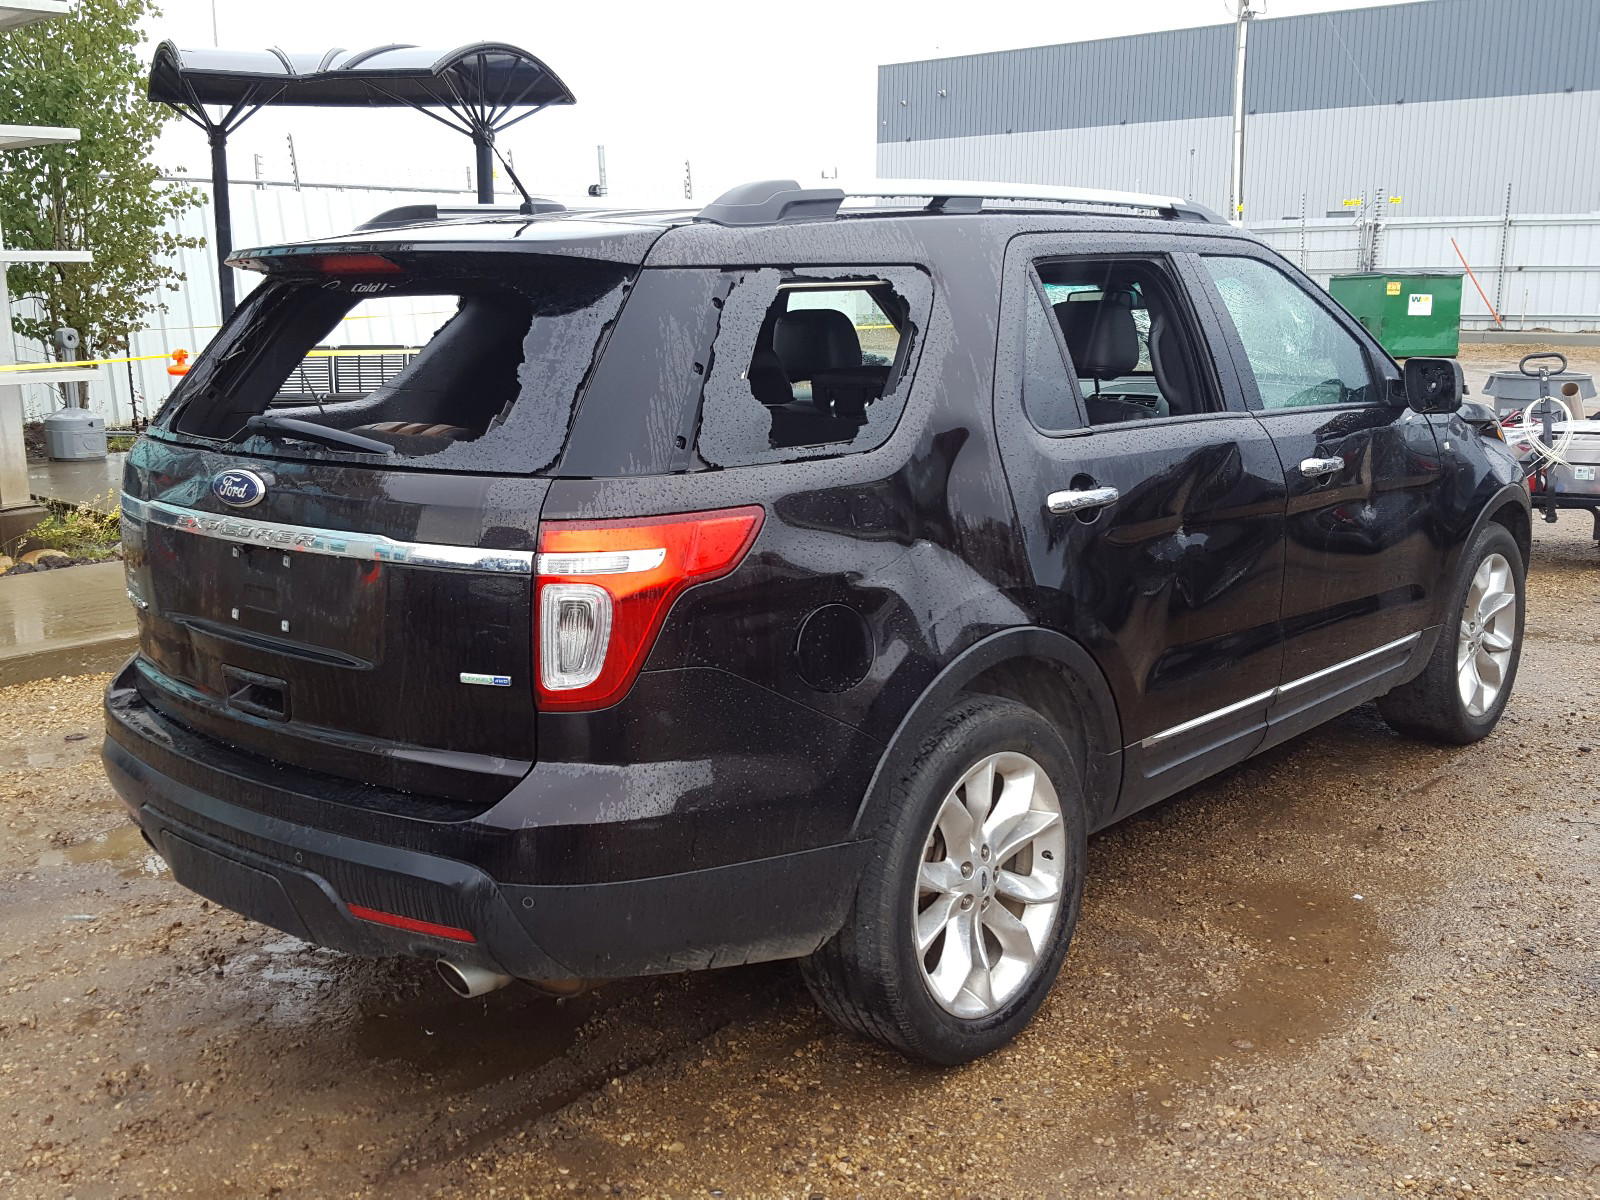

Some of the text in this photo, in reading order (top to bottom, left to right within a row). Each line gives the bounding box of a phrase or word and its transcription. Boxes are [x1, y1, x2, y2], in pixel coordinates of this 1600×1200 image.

[350, 283, 380, 293] Cold
[219, 475, 249, 499] Ford
[176, 513, 316, 548] EXPLORER
